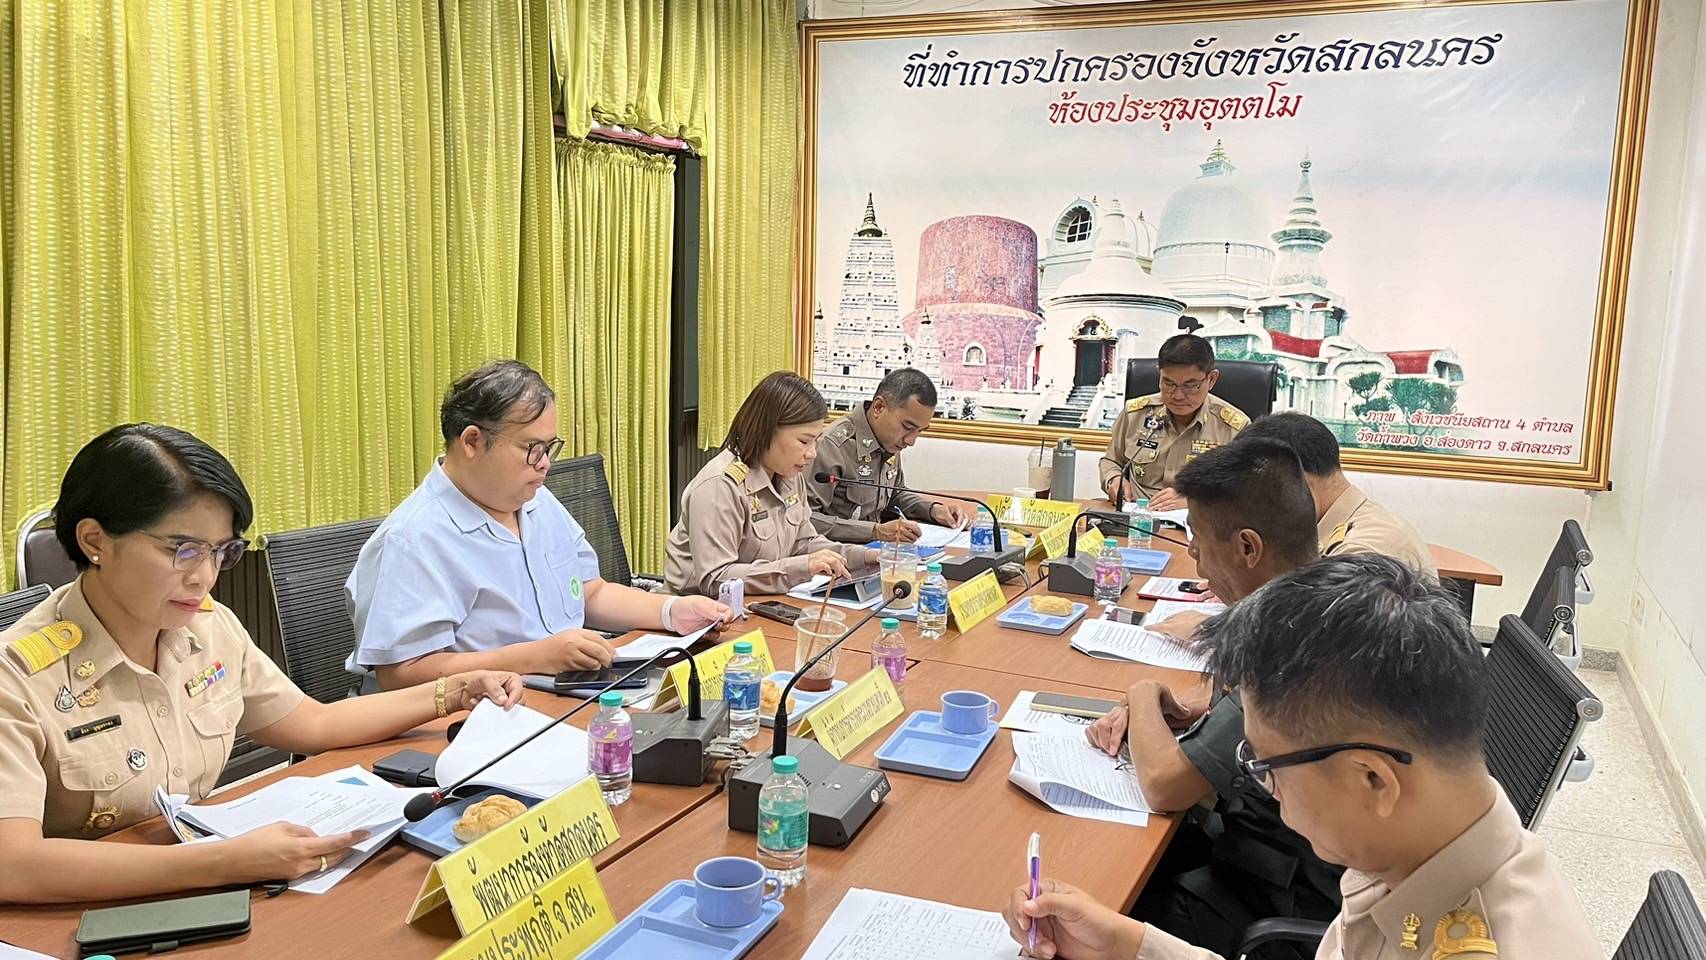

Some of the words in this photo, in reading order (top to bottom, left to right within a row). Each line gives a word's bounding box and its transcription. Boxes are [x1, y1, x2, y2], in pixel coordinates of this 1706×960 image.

[903, 33, 1503, 88] ที่ทำการปกครองจังหวัดสกลนคร
[1049, 81, 1303, 131] ห้องประชุมอุตตโม
[1357, 423, 1419, 445] วัดถ้ำพวง
[1424, 431, 1492, 450] อ.ส่องดาว
[1498, 440, 1573, 456] จ.สกลนคร
[1366, 411, 1396, 422] ภาพ
[1516, 419, 1526, 431] 4
[1532, 417, 1574, 434] ตำบล
[467, 811, 609, 922] พัฒนาการจังหวัดสกลนคร
